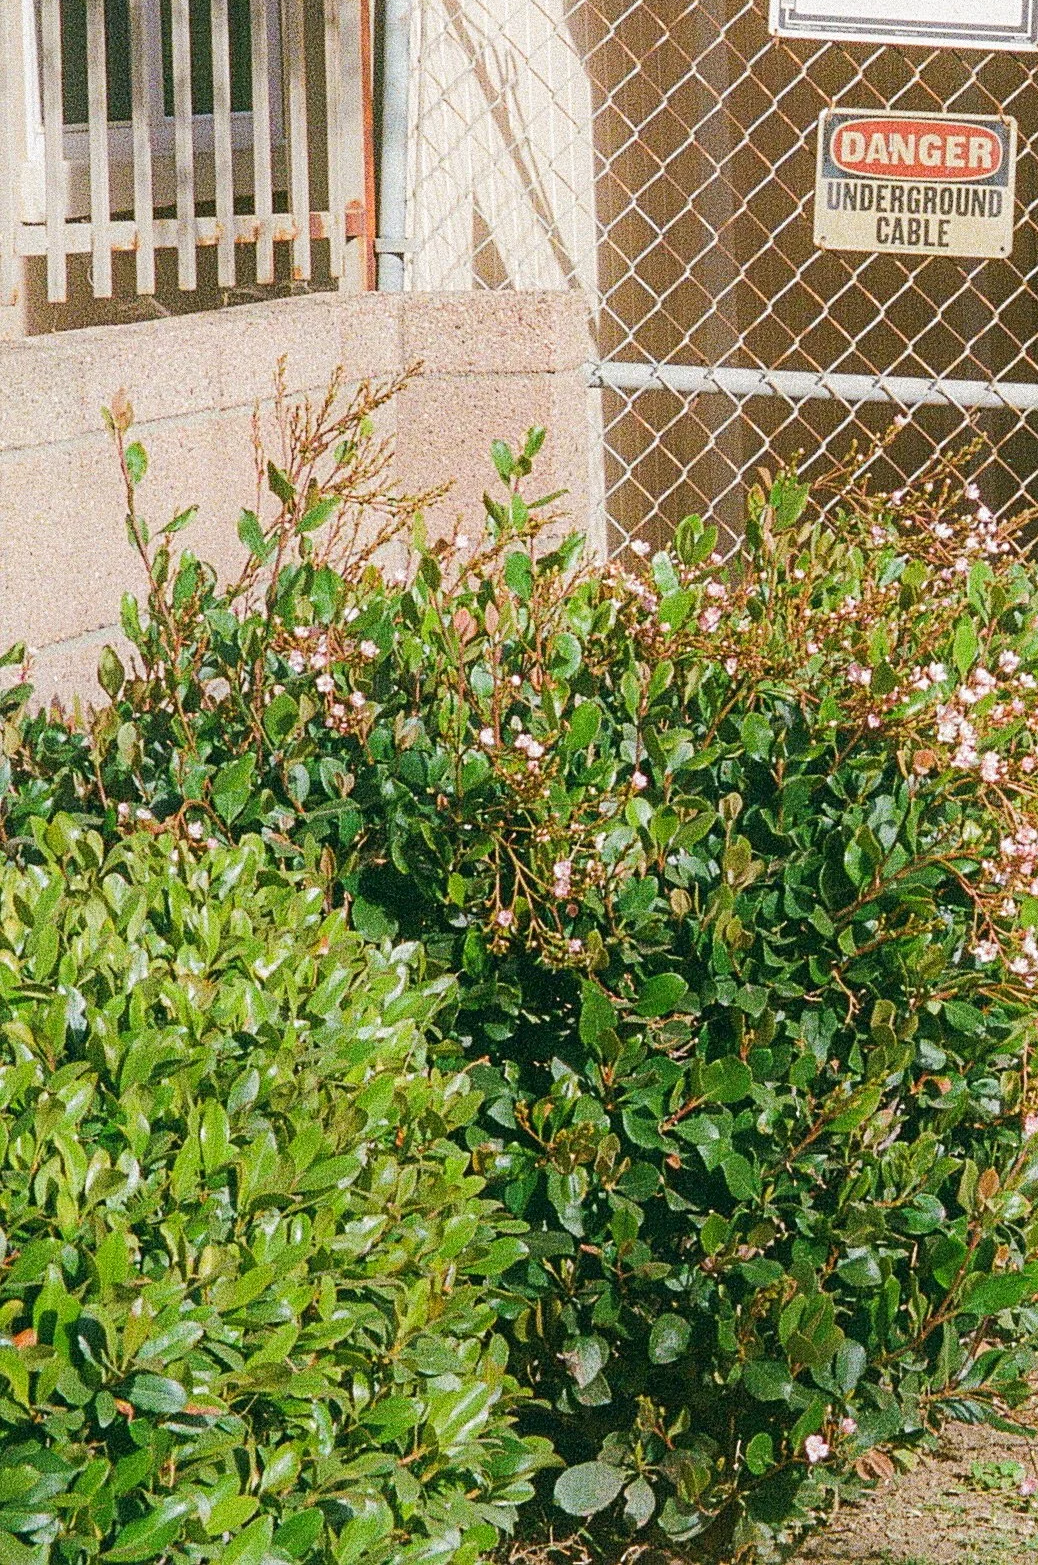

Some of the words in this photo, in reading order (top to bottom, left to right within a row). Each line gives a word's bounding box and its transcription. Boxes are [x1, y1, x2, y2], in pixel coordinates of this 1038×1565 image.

[840, 131, 993, 169] DANGER
[826, 182, 1003, 218] UNDERGROUND
[876, 216, 951, 248] CABLE
